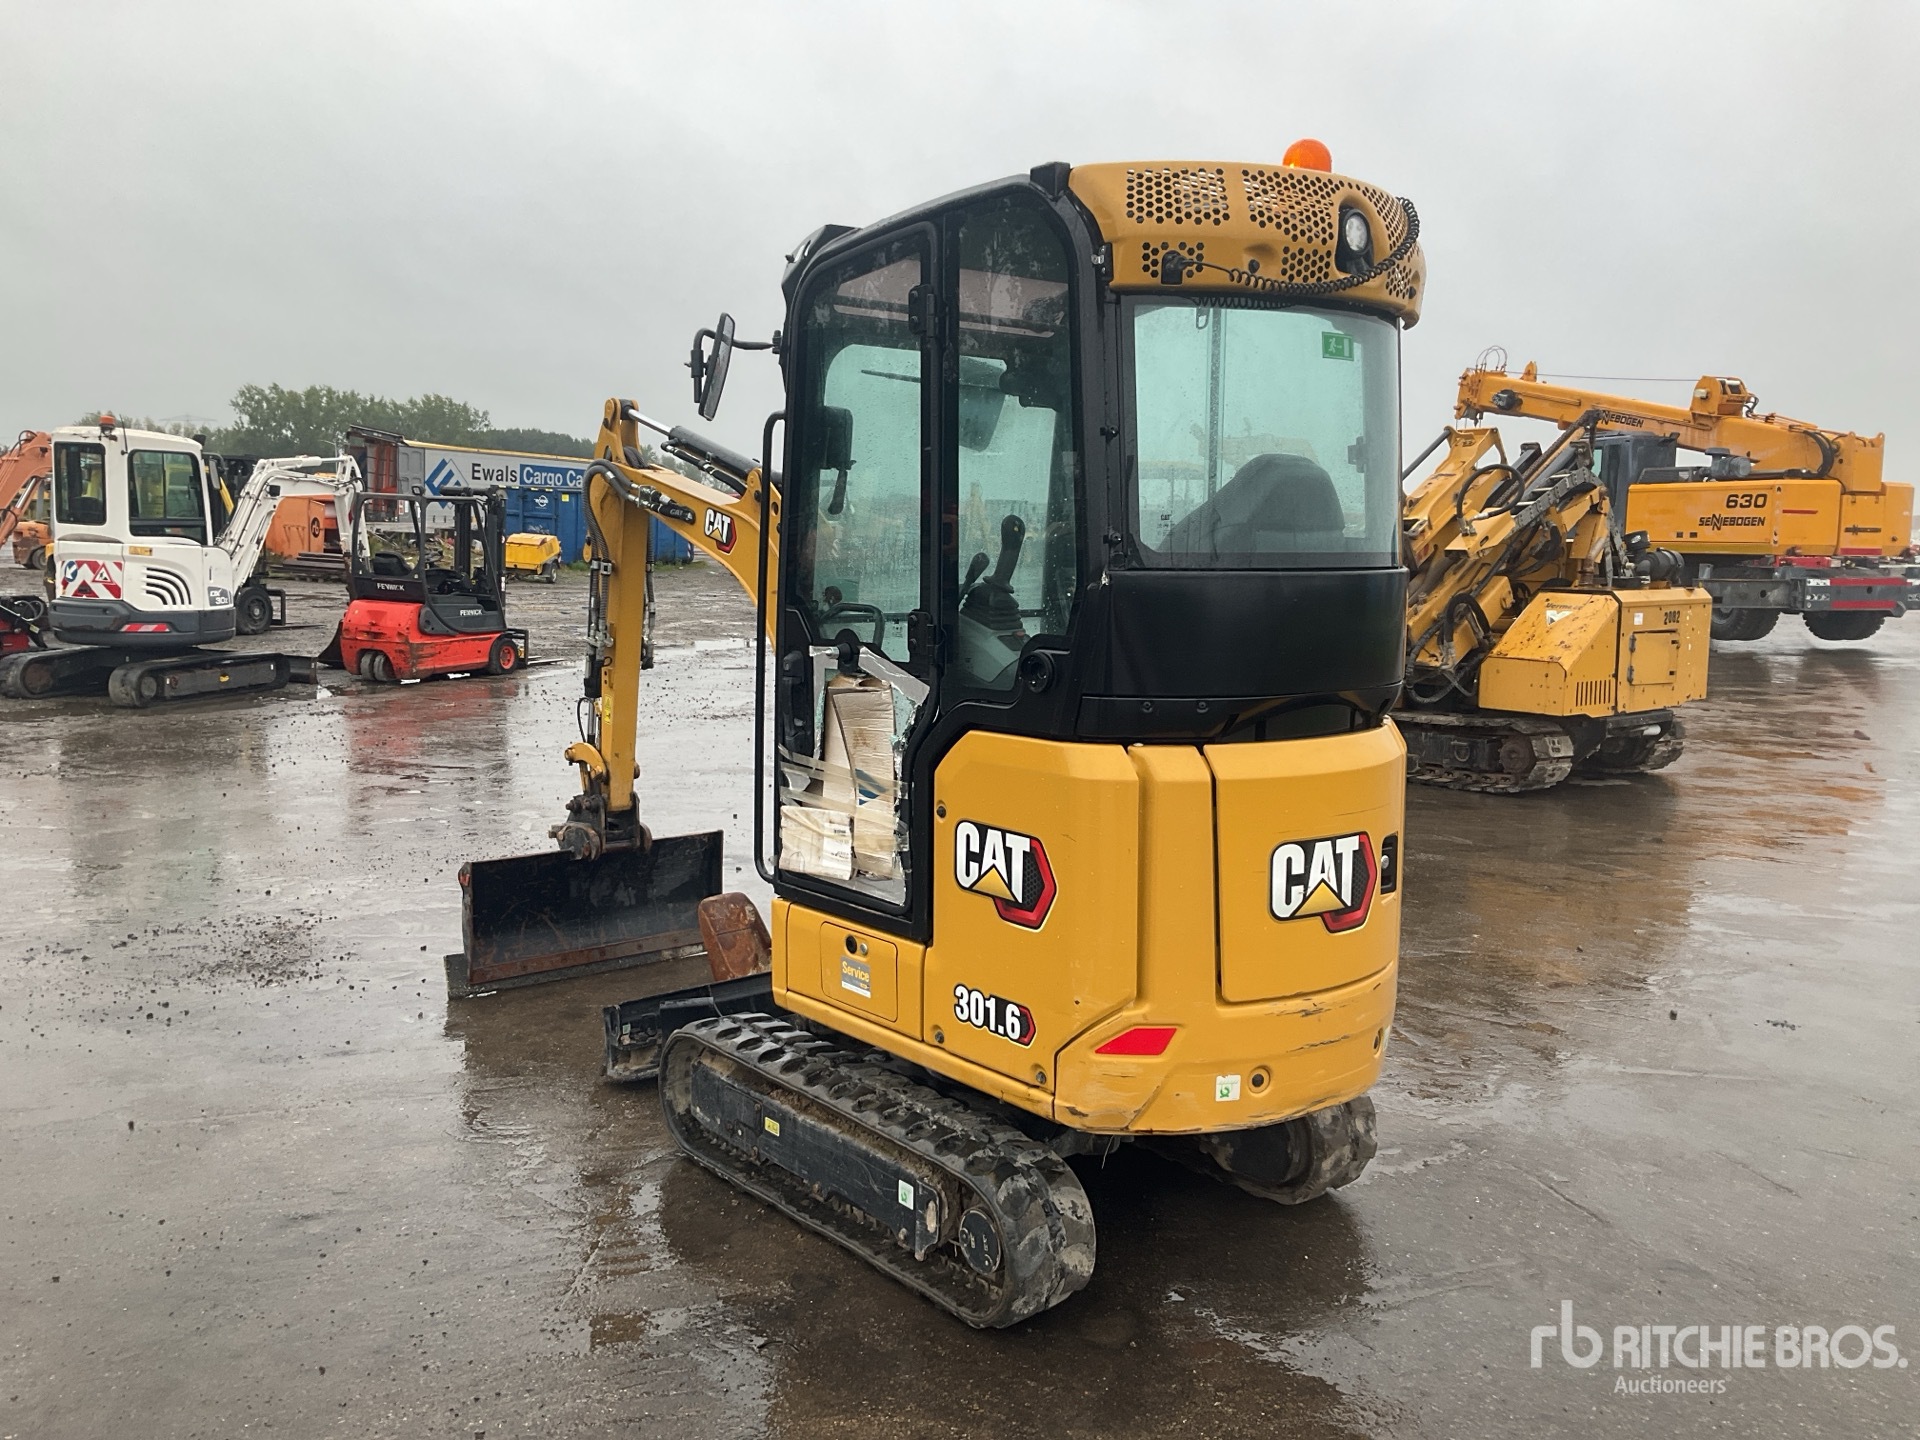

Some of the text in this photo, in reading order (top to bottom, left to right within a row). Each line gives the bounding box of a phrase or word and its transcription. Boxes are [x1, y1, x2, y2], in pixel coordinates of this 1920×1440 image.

[471, 463, 584, 487] Ewals Cargo Ca
[1726, 493, 1768, 509] 630
[704, 509, 731, 544] CAT
[956, 821, 1031, 904] CAT
[1271, 834, 1361, 918] CAT
[842, 960, 870, 983] Service
[954, 985, 1021, 1040] 301.6
